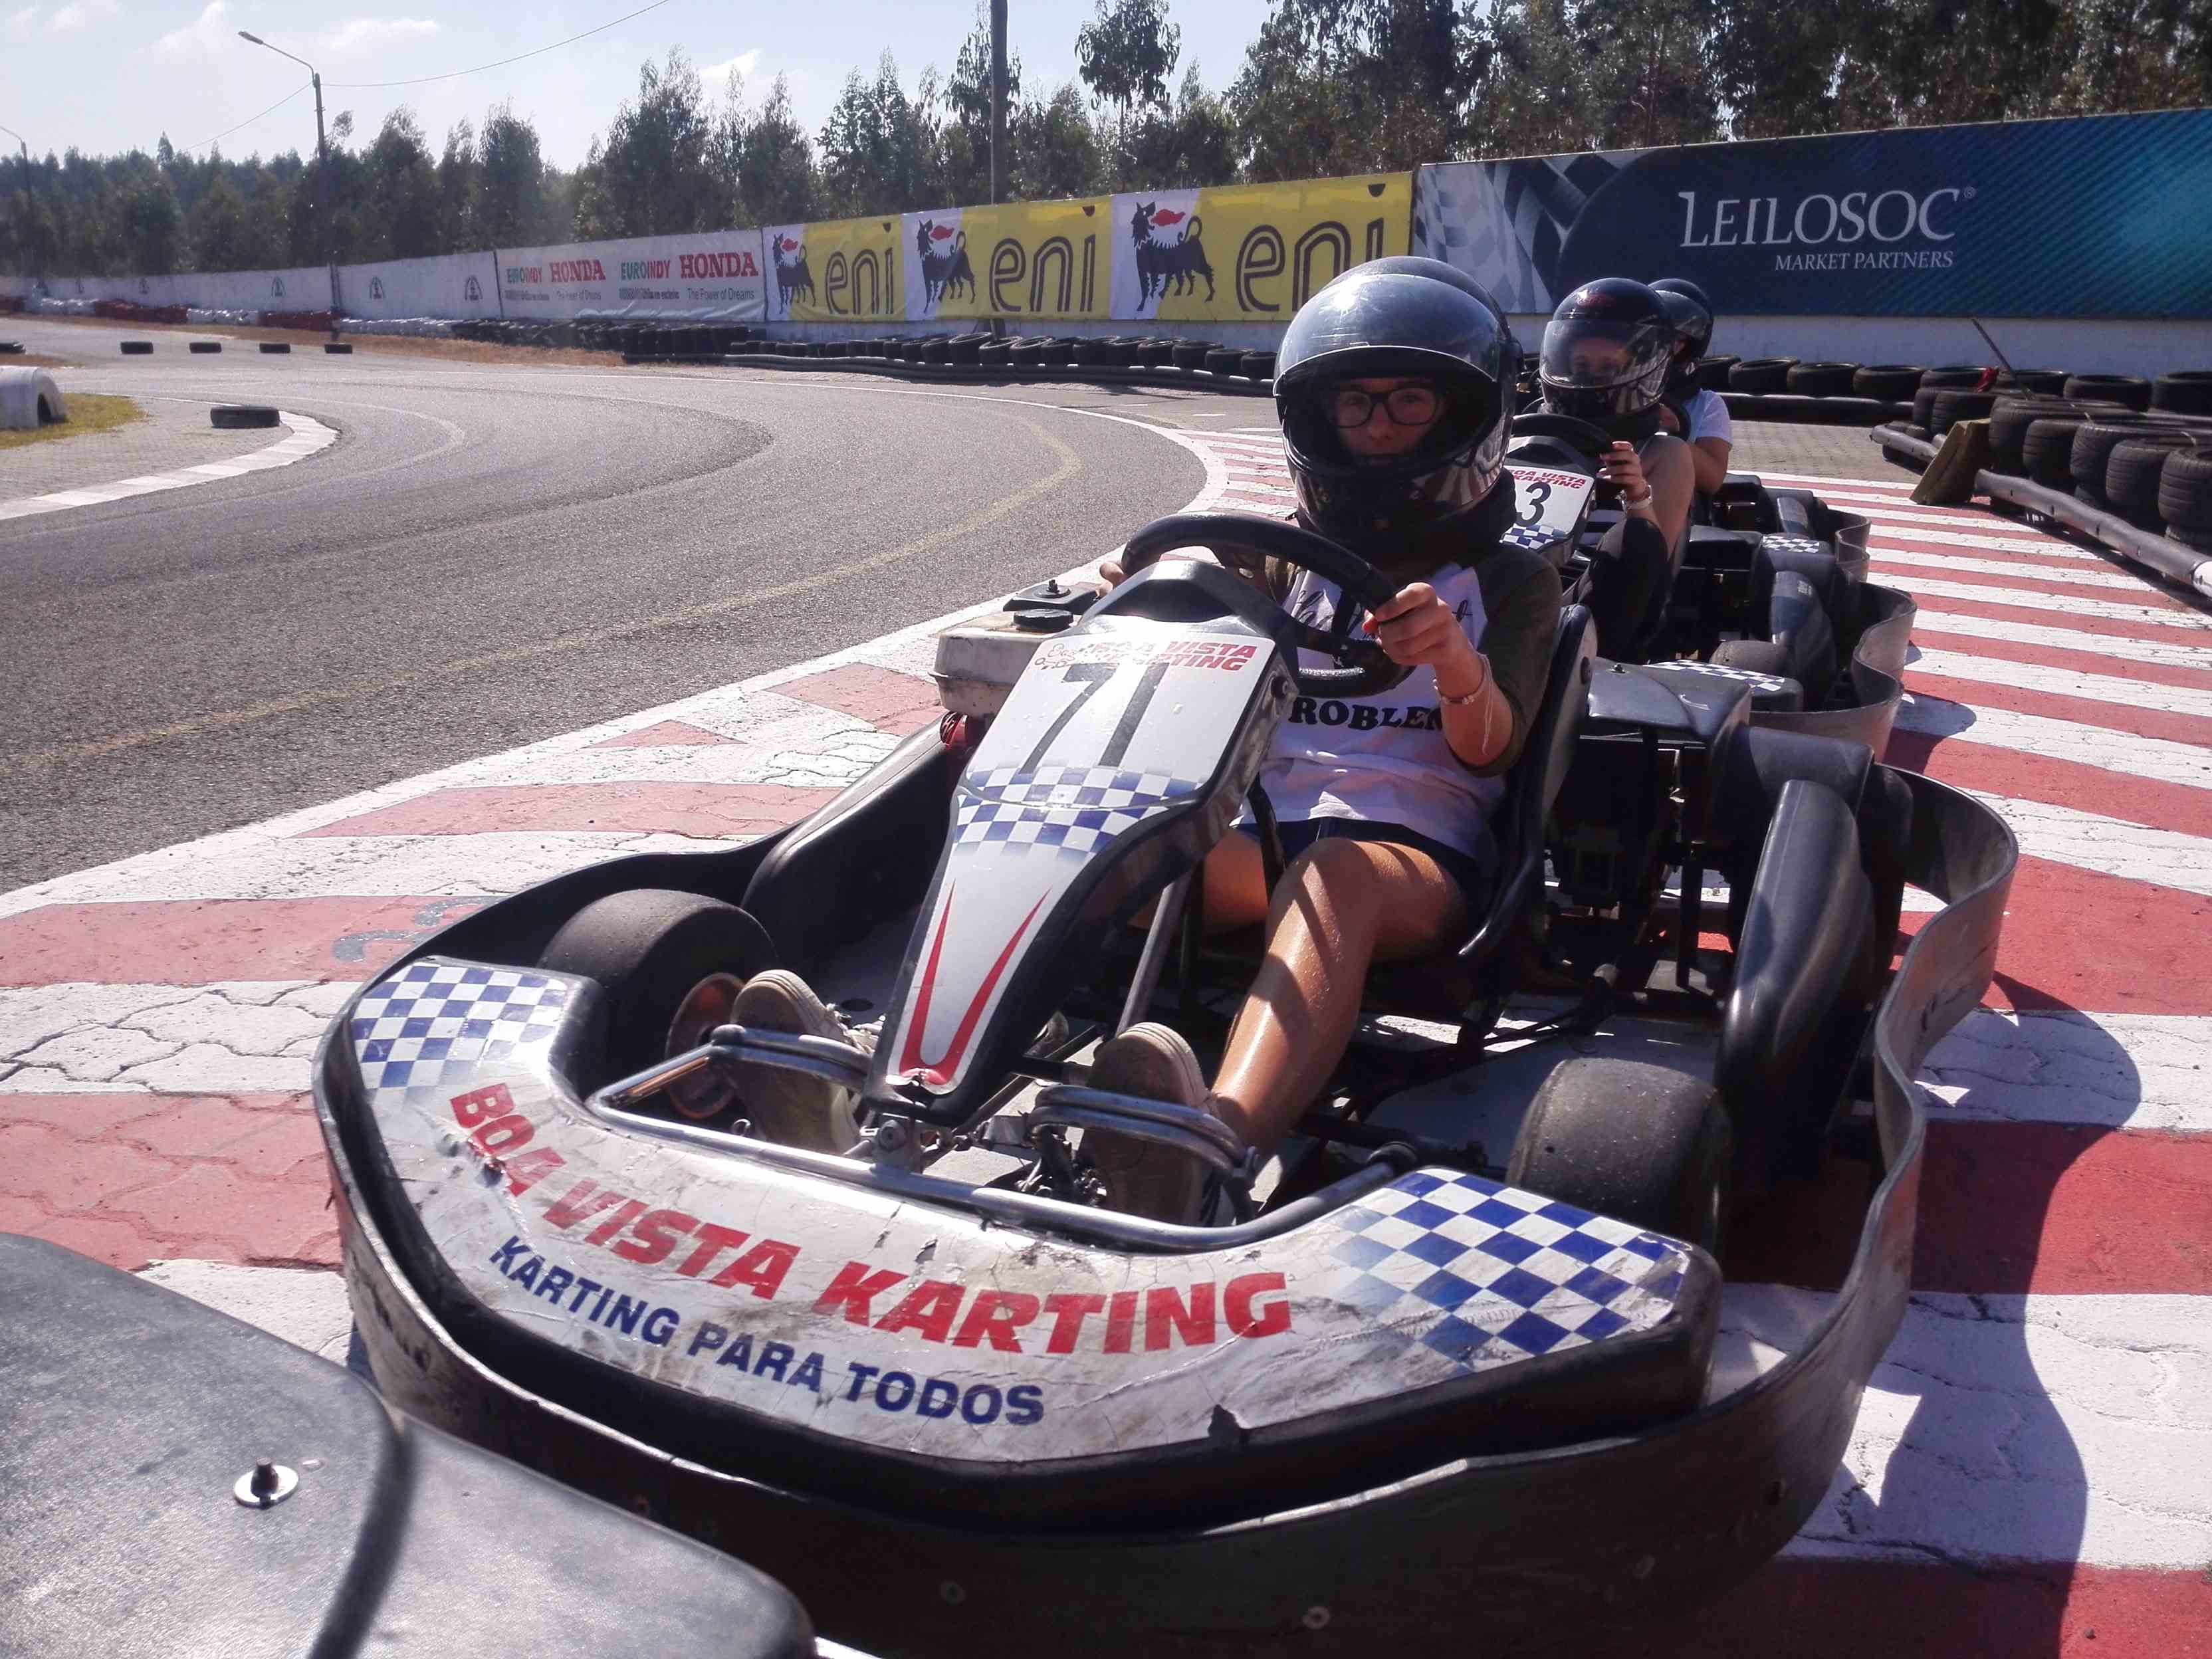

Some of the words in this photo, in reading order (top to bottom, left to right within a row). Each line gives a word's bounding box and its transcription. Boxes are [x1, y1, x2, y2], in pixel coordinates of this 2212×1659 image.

[989, 205, 1096, 312] eni
[1236, 183, 1386, 312] eni
[550, 259, 606, 282] HONDA
[621, 260, 671, 280] EUROINDY
[679, 252, 759, 278] HONDA
[825, 223, 894, 314] eni
[1775, 253, 1850, 271] MARKET
[1854, 251, 1953, 269] PARTNERS
[728, 286, 755, 299] Dreams
[1542, 473, 1586, 485] VISTA
[1515, 482, 1551, 527] 3
[1164, 641, 1258, 658] VISTA
[449, 1083, 566, 1196] BOA
[542, 1180, 801, 1300] VISTA
[810, 1261, 1292, 1355] KARTING
[489, 1236, 681, 1347] KARTING
[687, 1321, 825, 1394] PARA
[845, 1361, 1045, 1426] TODOS
